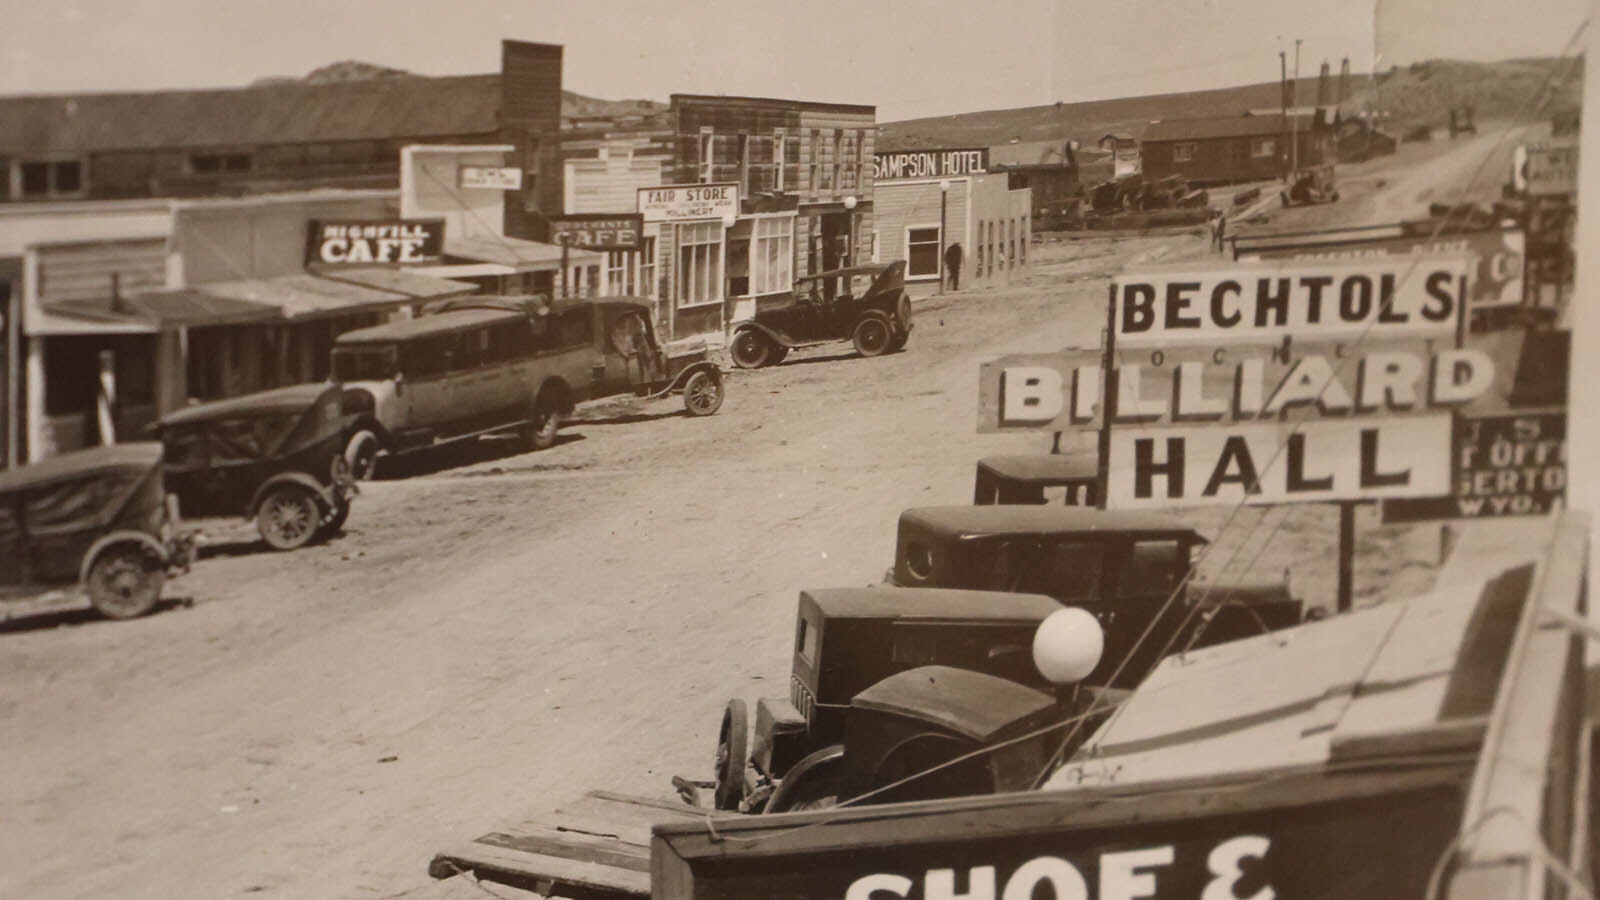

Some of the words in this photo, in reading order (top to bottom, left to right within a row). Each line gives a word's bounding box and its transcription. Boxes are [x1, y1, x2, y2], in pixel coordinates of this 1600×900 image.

[873, 153, 937, 179] SAMPSON
[941, 151, 987, 175] HOTEL
[686, 187, 729, 201] STORE
[320, 239, 425, 263] CAFE
[553, 229, 636, 246] CAFE
[1120, 271, 1457, 333] BECHTOLS
[998, 349, 1496, 427] BILLIARD
[1133, 428, 1412, 499] HALL
